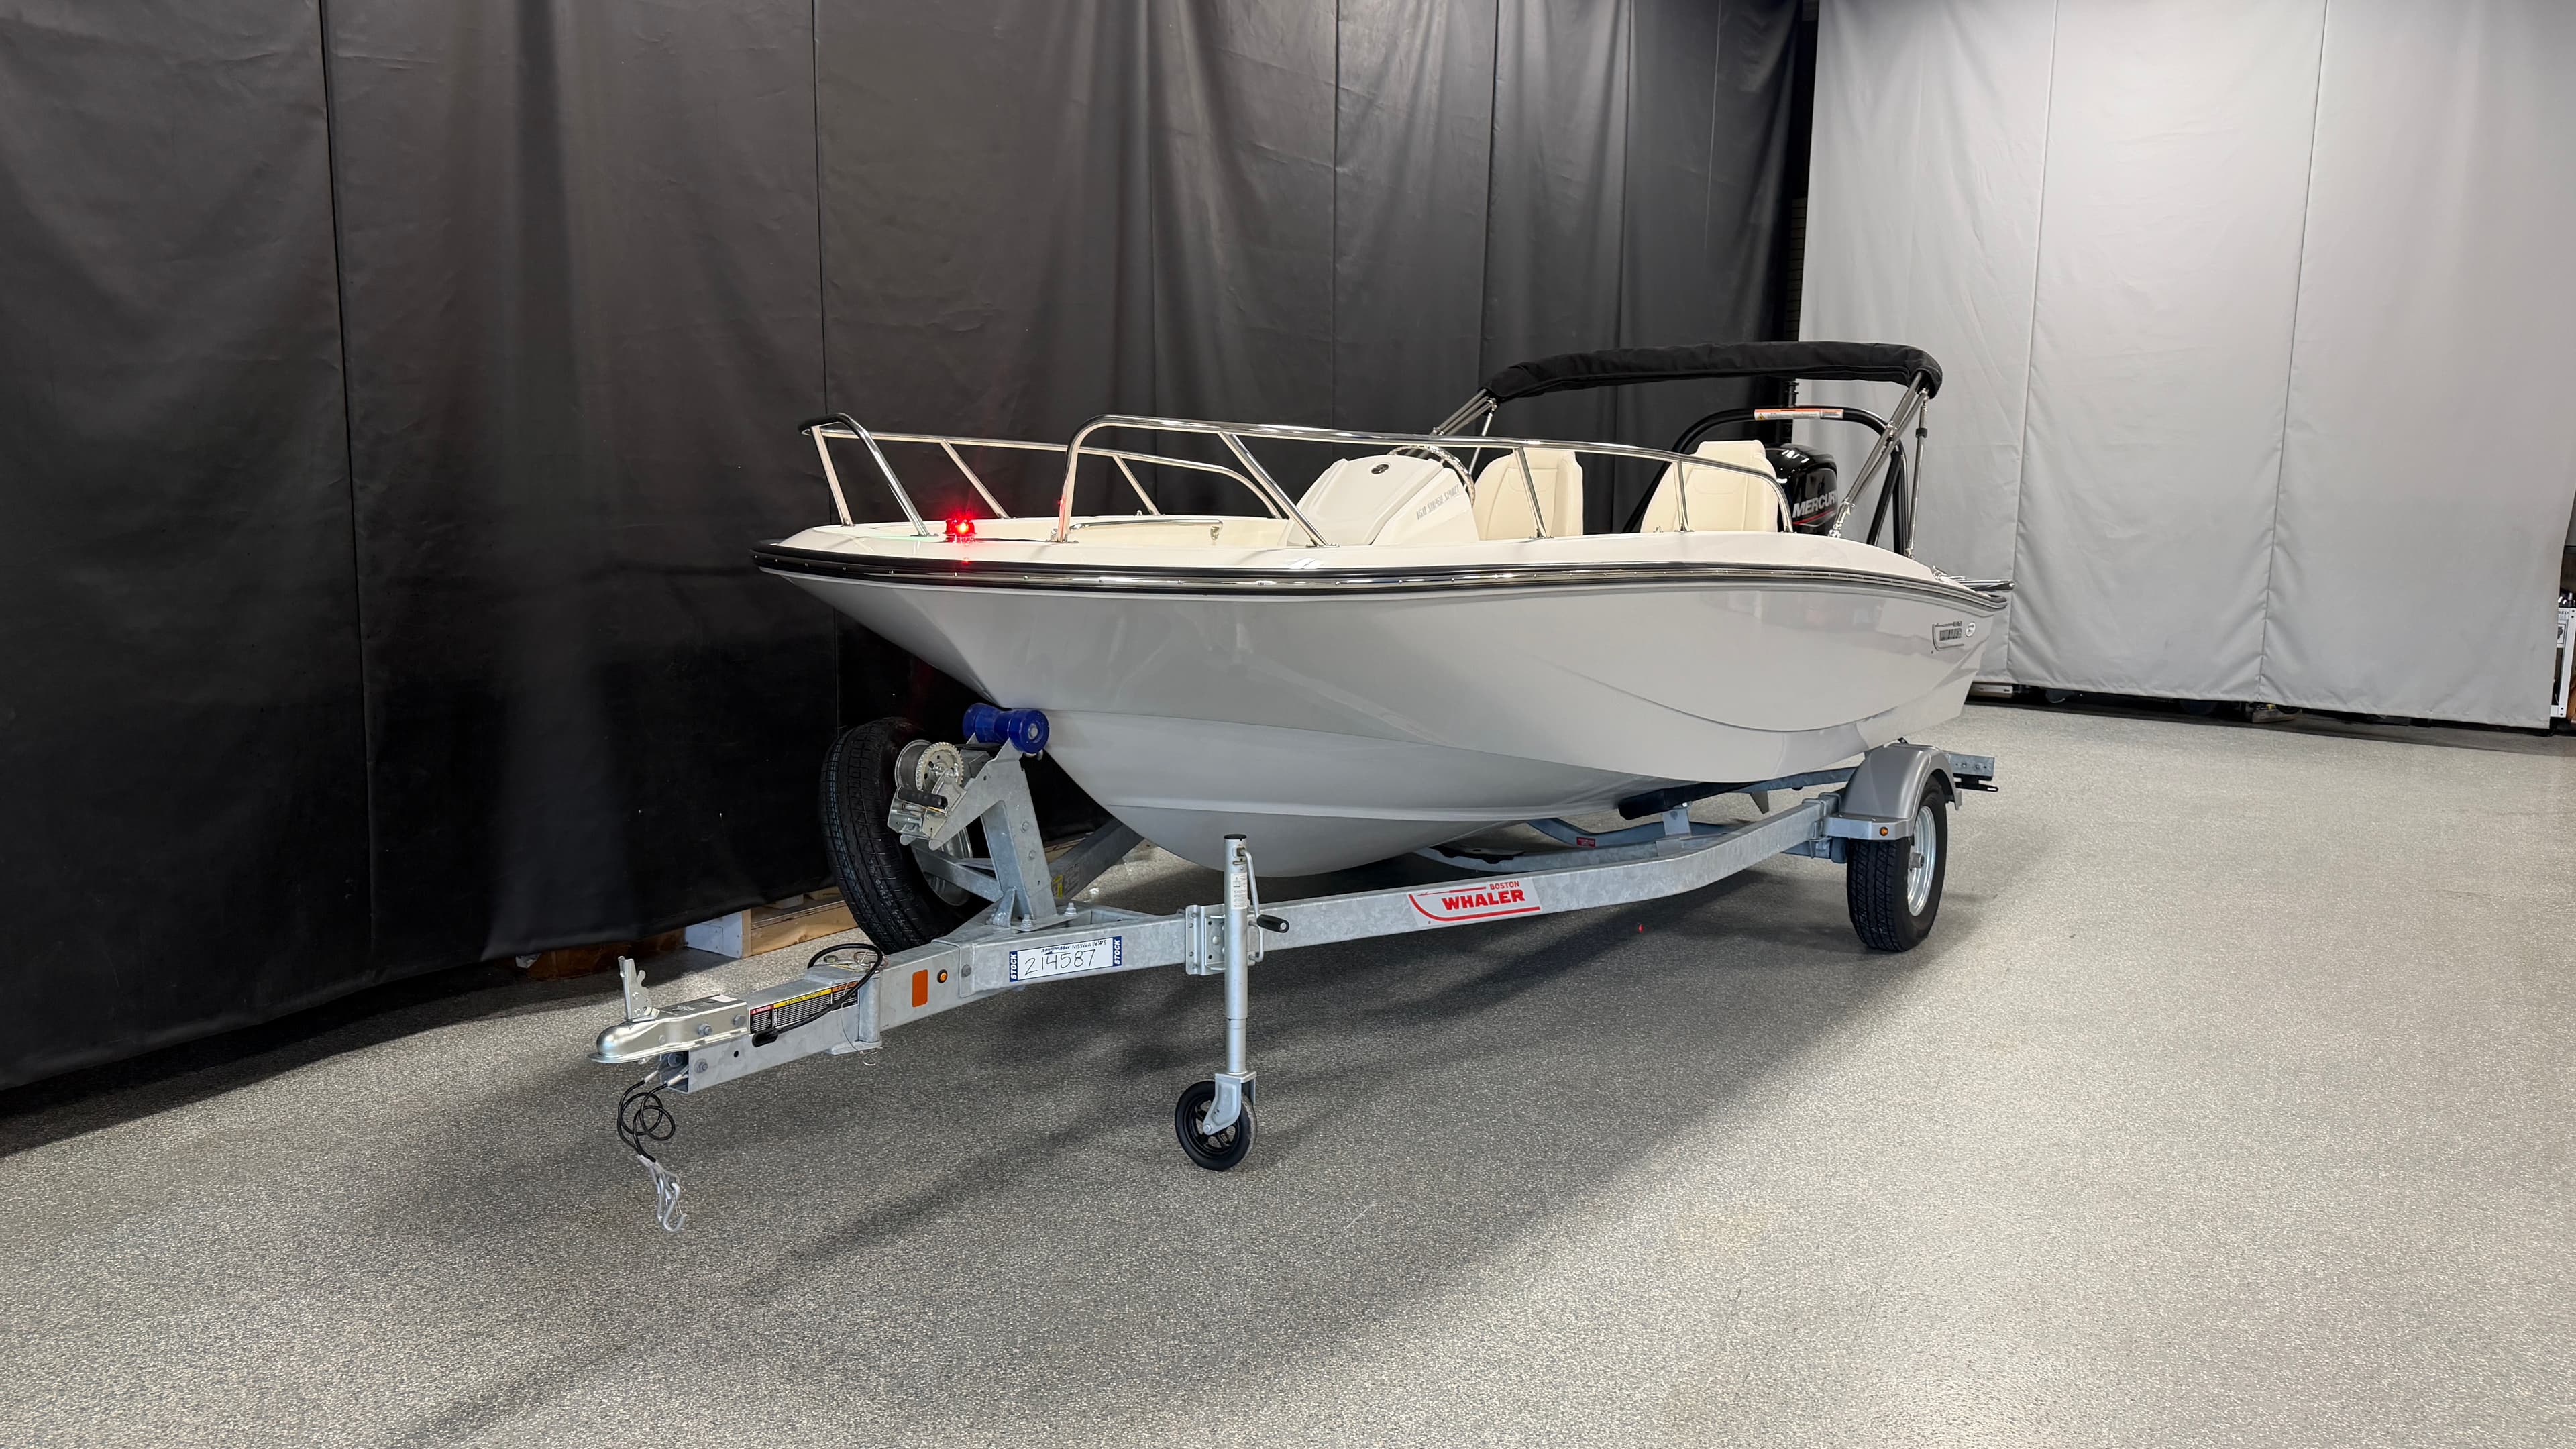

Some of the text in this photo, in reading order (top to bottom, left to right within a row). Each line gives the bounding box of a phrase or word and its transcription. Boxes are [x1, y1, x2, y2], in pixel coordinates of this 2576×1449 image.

[1792, 490, 1837, 518] MERCUR
[1489, 881, 1519, 890] BOSTON
[1441, 889, 1525, 910] WHALER
[1025, 949, 1095, 975] 214587
